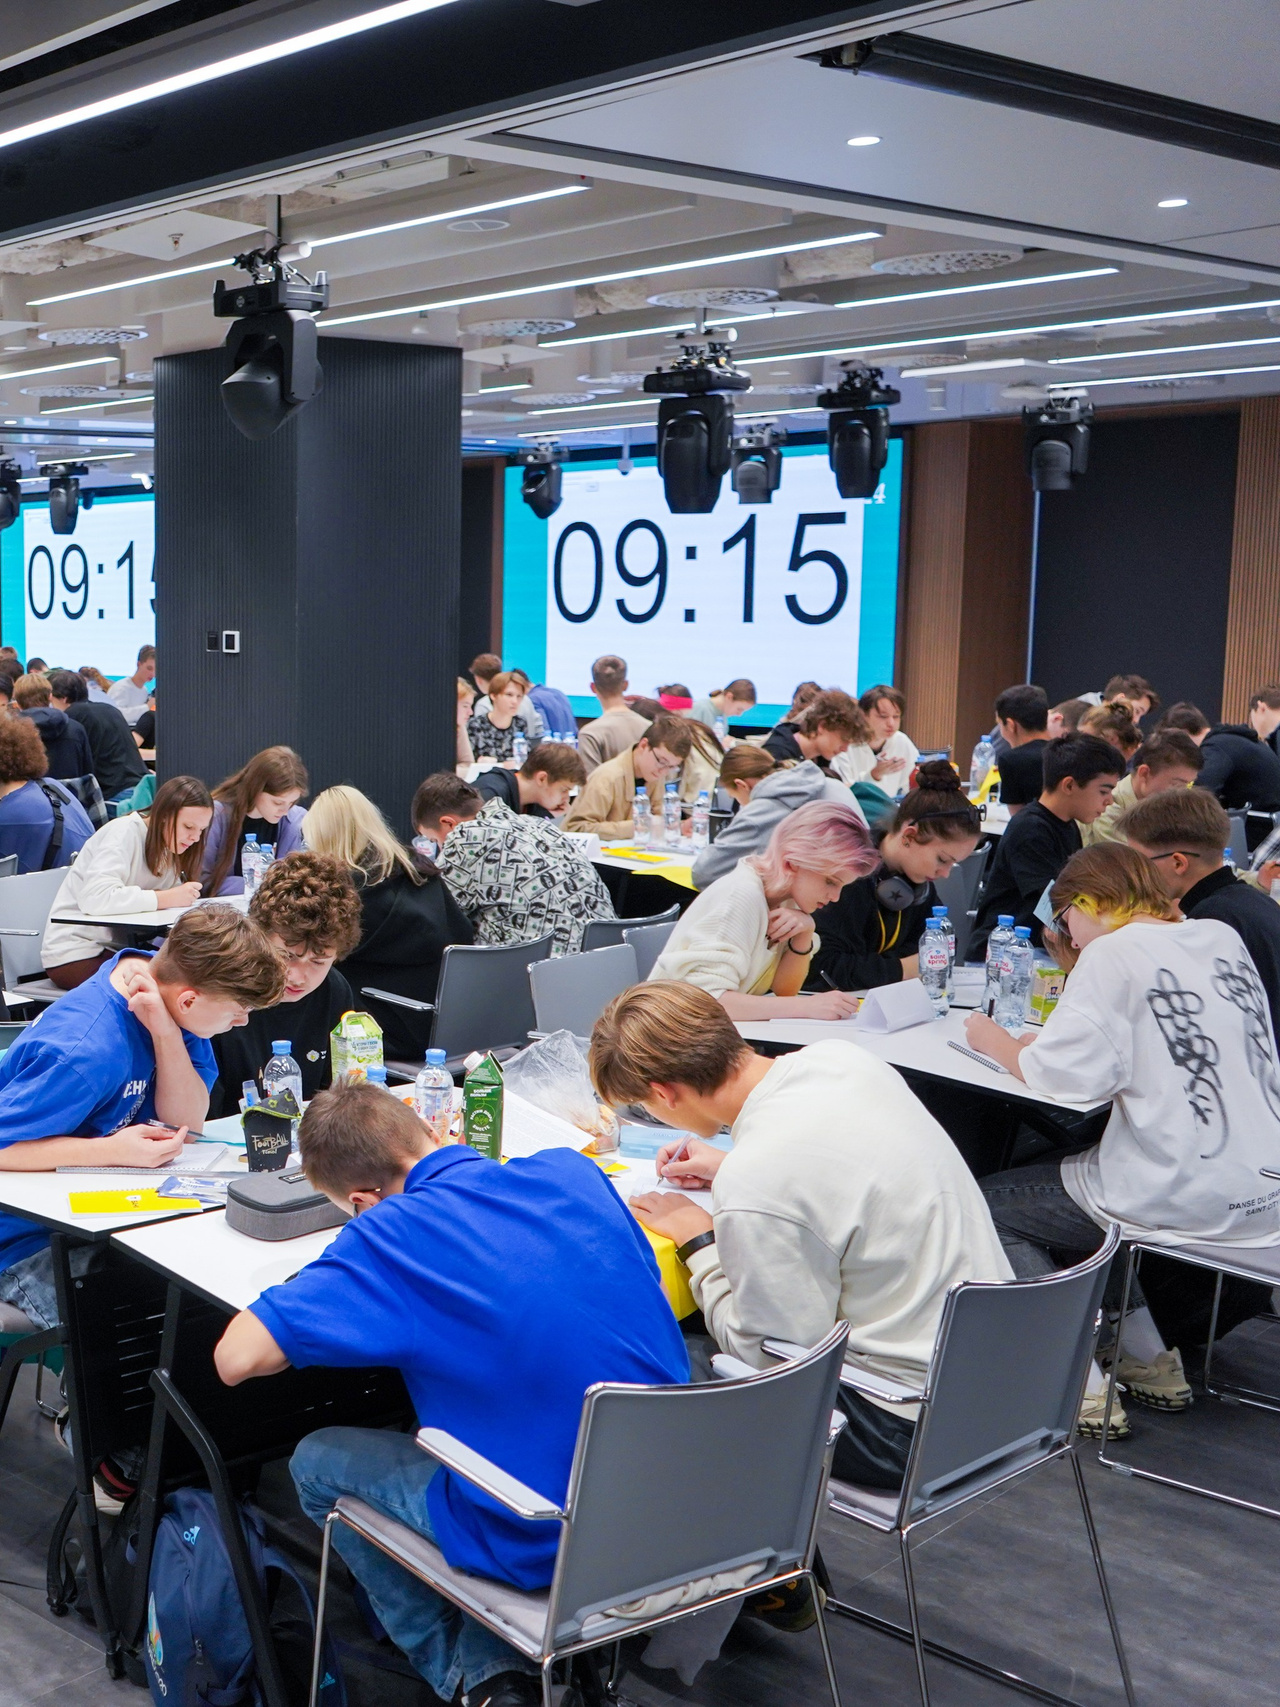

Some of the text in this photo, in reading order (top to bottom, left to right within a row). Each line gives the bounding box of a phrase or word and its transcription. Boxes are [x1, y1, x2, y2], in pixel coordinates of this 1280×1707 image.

[28, 540, 155, 620] 09:1
[554, 512, 848, 625] 09:15
[1228, 1199, 1256, 1211] DANSE
[1257, 1196, 1267, 1205] DU
[1245, 1205, 1267, 1217] SAINT
